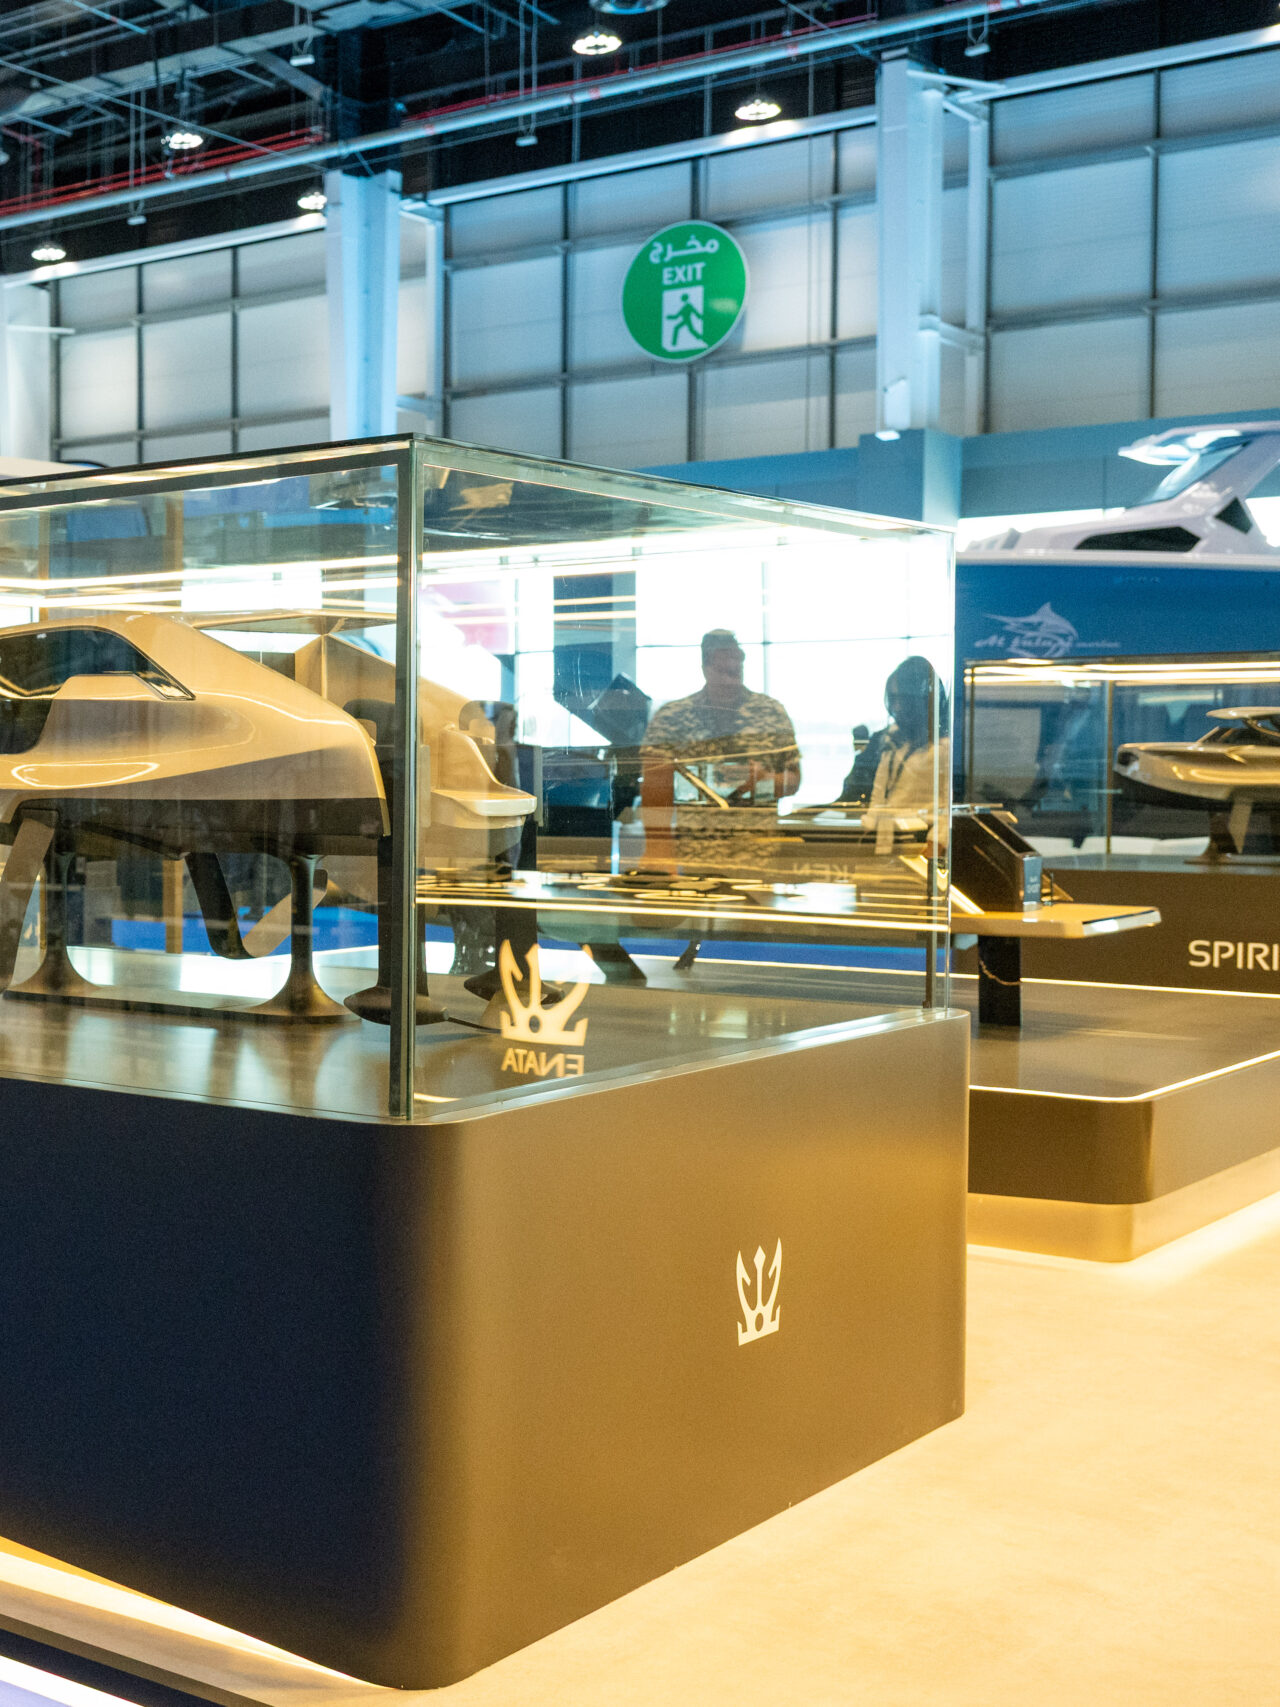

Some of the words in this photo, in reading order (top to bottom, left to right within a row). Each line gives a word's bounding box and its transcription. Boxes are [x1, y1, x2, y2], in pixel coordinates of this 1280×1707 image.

[649, 234, 719, 264] مخرج
[662, 262, 706, 285] EXIT
[1188, 939, 1280, 972] SPIRI
